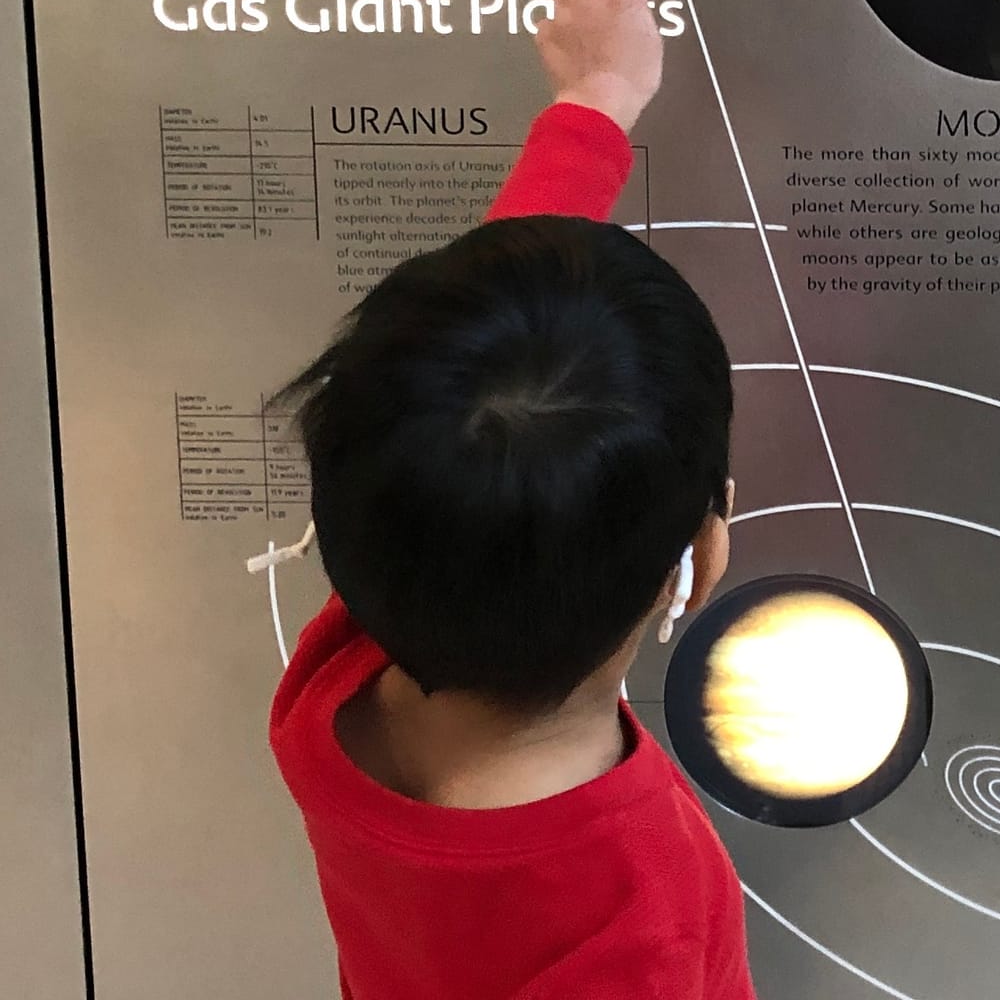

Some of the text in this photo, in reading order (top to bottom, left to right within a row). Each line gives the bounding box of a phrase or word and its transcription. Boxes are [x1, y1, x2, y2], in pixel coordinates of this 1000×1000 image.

[331, 106, 488, 136] URANUS
[782, 145, 812, 160] The
[821, 148, 863, 160] more
[873, 146, 910, 160] than
[919, 146, 958, 165] sixty
[334, 158, 506, 172] The rotation axis of Uranus
[786, 171, 845, 186] diverse
[854, 172, 934, 187] collection
[943, 172, 958, 187] of
[792, 197, 843, 216] planet
[850, 198, 921, 217] Mercury.
[929, 198, 974, 213] Some
[797, 224, 840, 238] while
[849, 224, 902, 239] others
[911, 228, 936, 239] are
[802, 253, 857, 265] moons
[864, 253, 922, 269] appear
[930, 251, 947, 265] to
[955, 251, 973, 265] be
[808, 275, 826, 294] by
[831, 275, 857, 290] the
[863, 276, 921, 295] gravity
[926, 276, 941, 291] of
[948, 277, 985, 292] their
